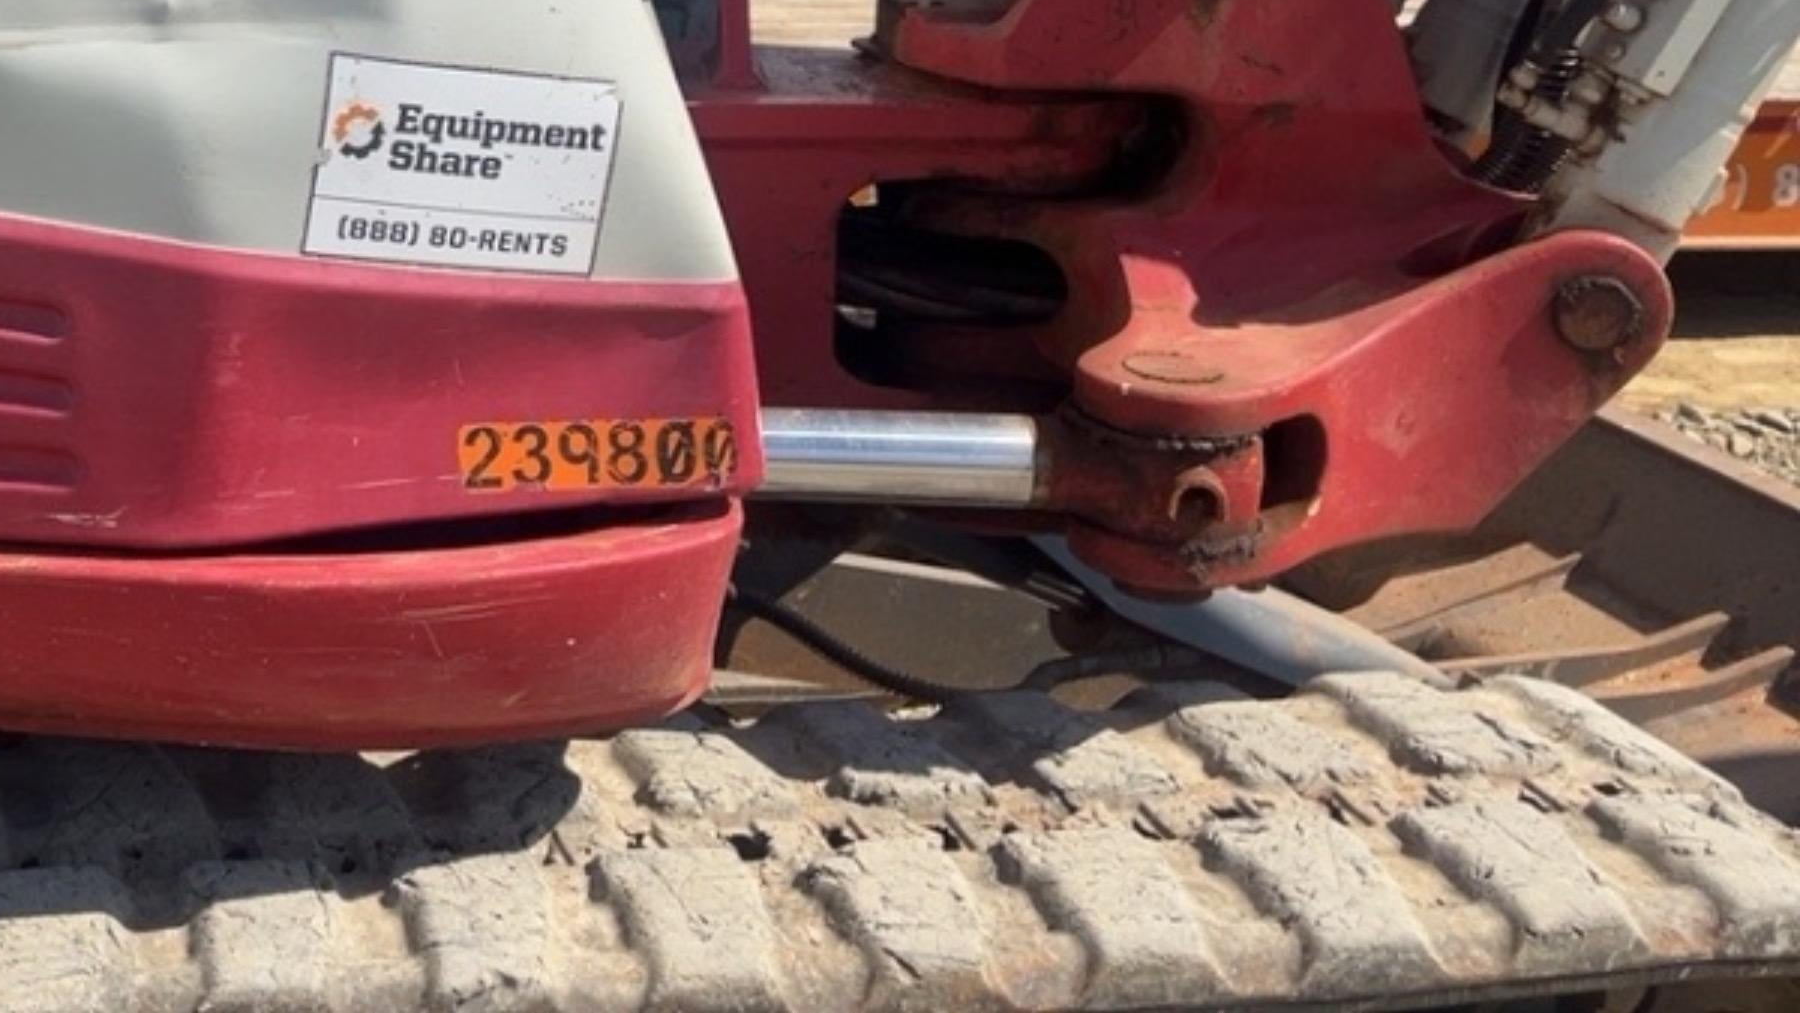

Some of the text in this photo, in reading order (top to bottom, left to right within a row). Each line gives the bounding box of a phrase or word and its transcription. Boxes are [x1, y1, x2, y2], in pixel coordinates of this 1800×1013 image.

[394, 103, 607, 152] Equipment
[388, 139, 503, 180] Share
[337, 215, 569, 256] (888) 80-RENTS
